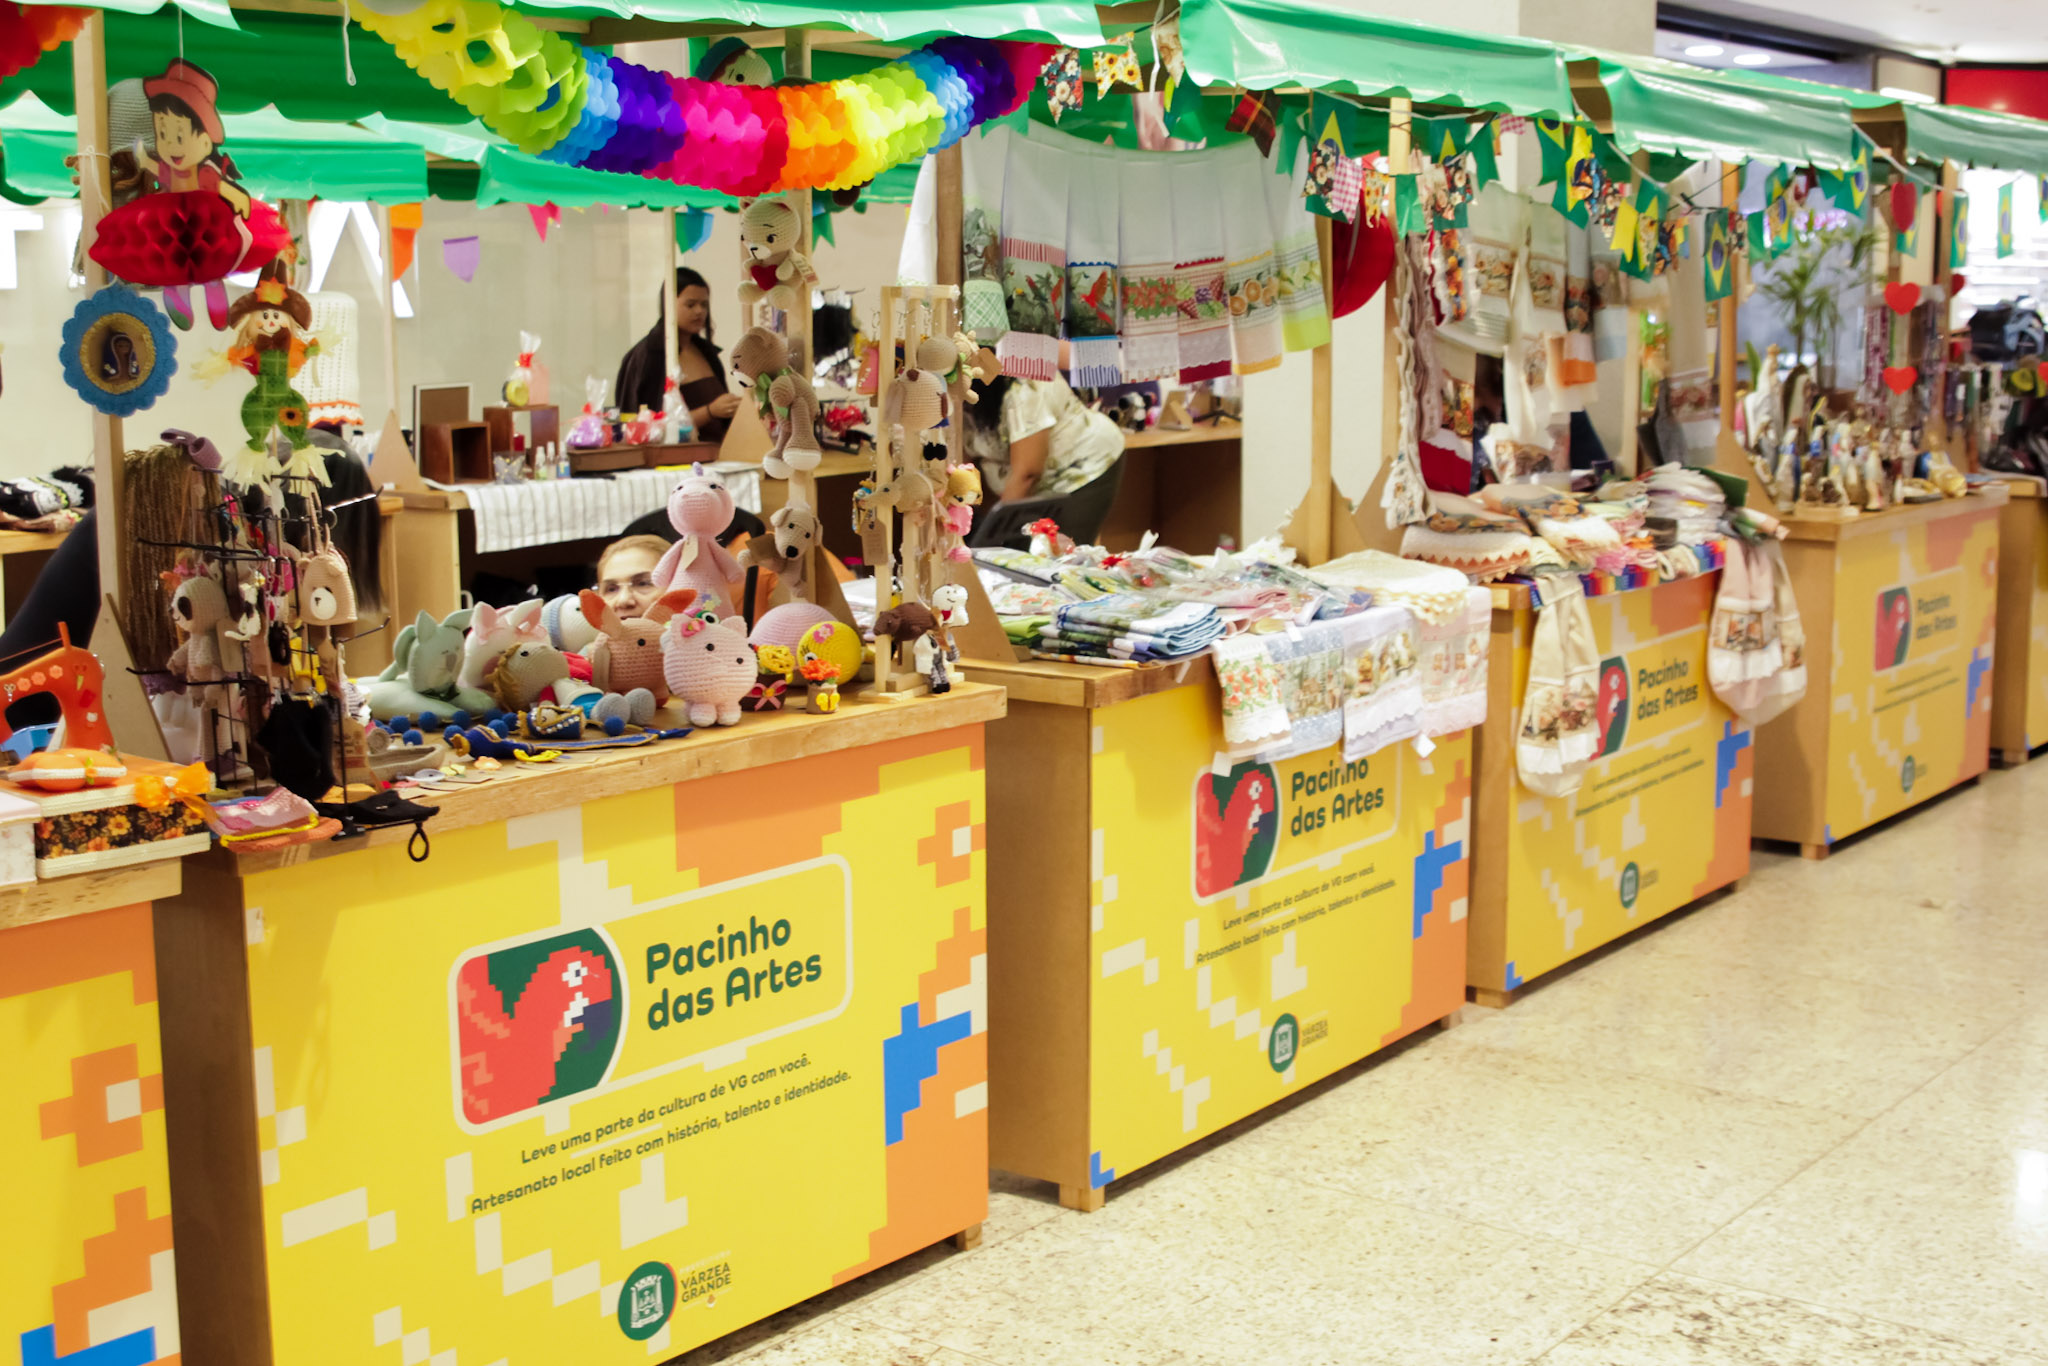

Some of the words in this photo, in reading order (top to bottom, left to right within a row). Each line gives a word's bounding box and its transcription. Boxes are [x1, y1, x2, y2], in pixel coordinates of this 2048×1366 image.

[1291, 805, 1325, 837] das
[1332, 787, 1384, 823] Artes
[647, 915, 791, 984] Pacinho
[648, 987, 714, 1031] das
[726, 954, 822, 1007] Artes
[471, 1173, 558, 1214] Artesanato
[562, 1157, 596, 1182] local
[599, 1147, 632, 1169] feito
[635, 1136, 664, 1155] com
[667, 1115, 722, 1144] história,
[725, 1098, 771, 1124] talento
[774, 1093, 782, 1106] e
[784, 1069, 852, 1103] identidade.
[521, 1141, 556, 1164] Leve
[561, 1130, 592, 1150] uma
[595, 1115, 634, 1141] parte
[638, 1107, 655, 1124] da
[658, 1090, 706, 1117] cultura
[710, 1083, 726, 1099] de
[728, 1074, 748, 1092] VG
[751, 1066, 777, 1084] com
[779, 1053, 812, 1074] você.
[680, 1262, 731, 1290] VÁRZEA
[681, 1273, 732, 1303] GRANDE
